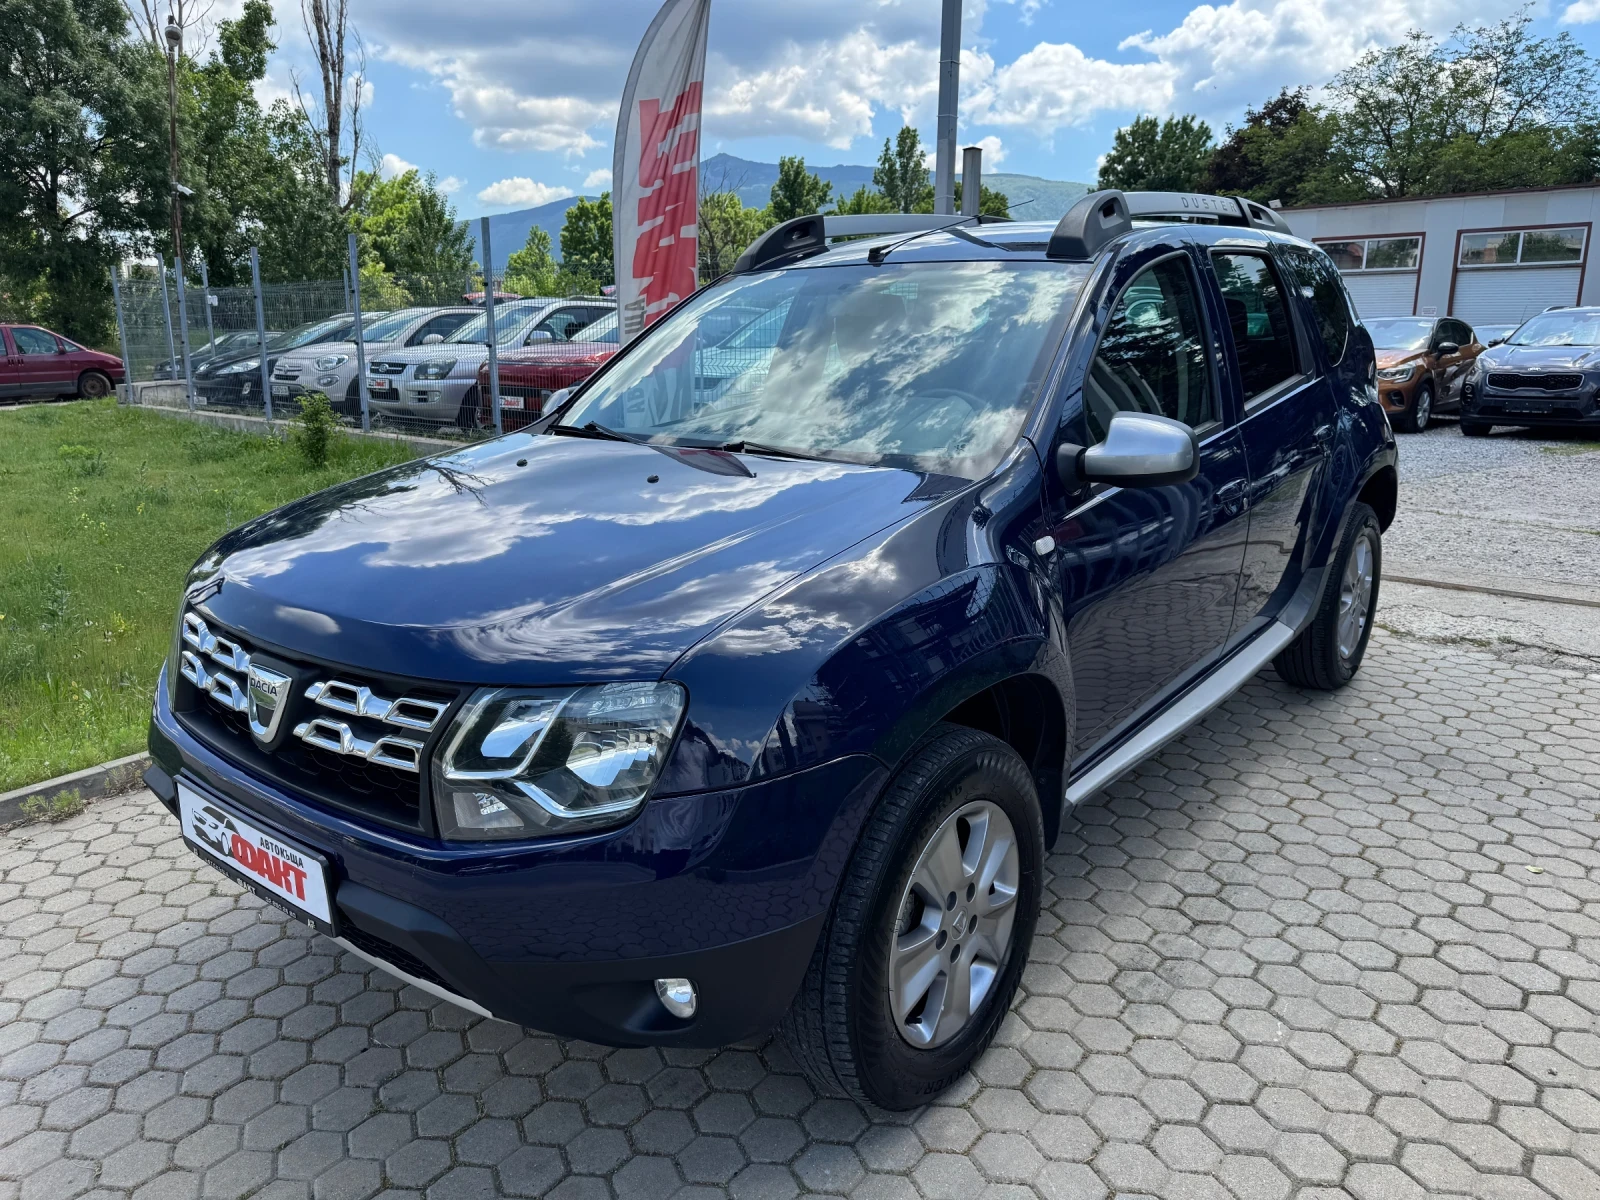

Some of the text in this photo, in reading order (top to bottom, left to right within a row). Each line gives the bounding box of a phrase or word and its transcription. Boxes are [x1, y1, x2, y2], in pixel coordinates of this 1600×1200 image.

[1181, 195, 1238, 213] DUSTER
[250, 676, 278, 697] DACIA
[259, 836, 304, 869] АВТОКЪЩА
[231, 833, 307, 901] ФАКТ
